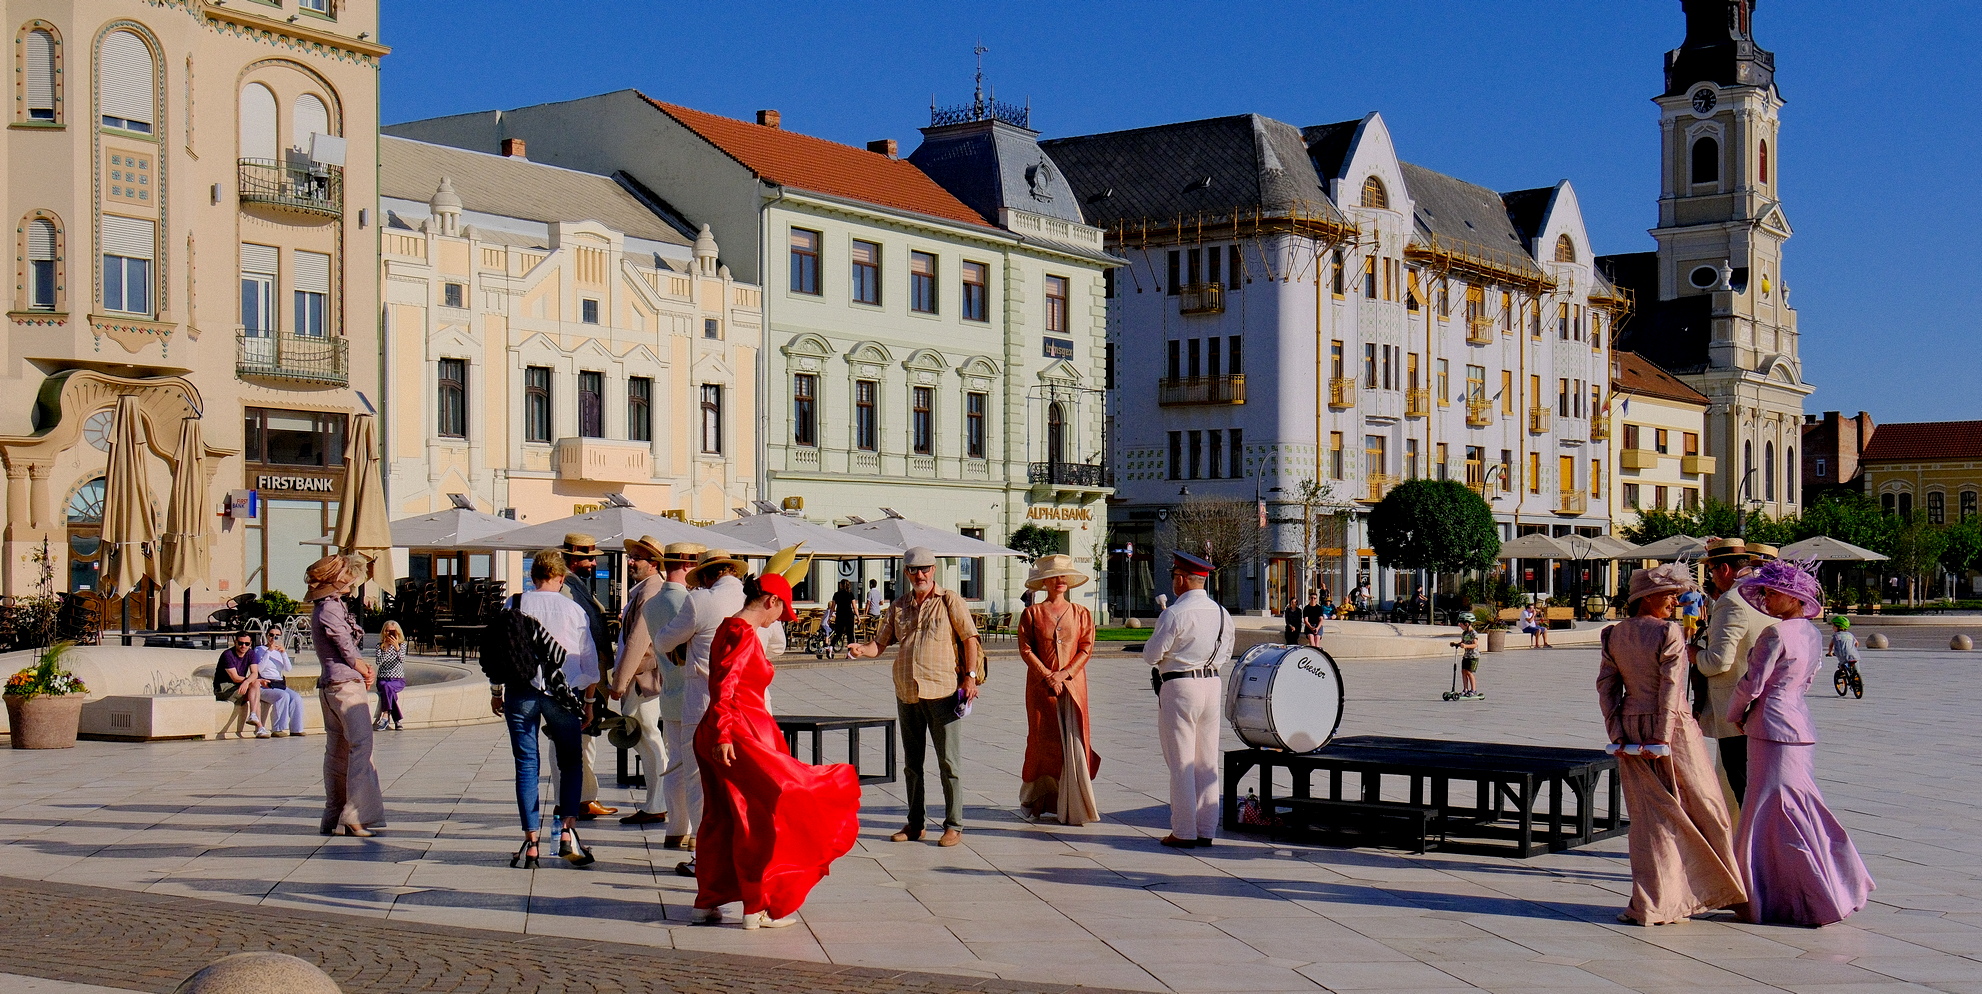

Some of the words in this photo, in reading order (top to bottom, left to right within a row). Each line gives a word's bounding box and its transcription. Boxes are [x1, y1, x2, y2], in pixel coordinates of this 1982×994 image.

[1026, 506, 1060, 520] ALPHA
[1061, 507, 1092, 521] BANK
[1297, 656, 1326, 680] Chester
